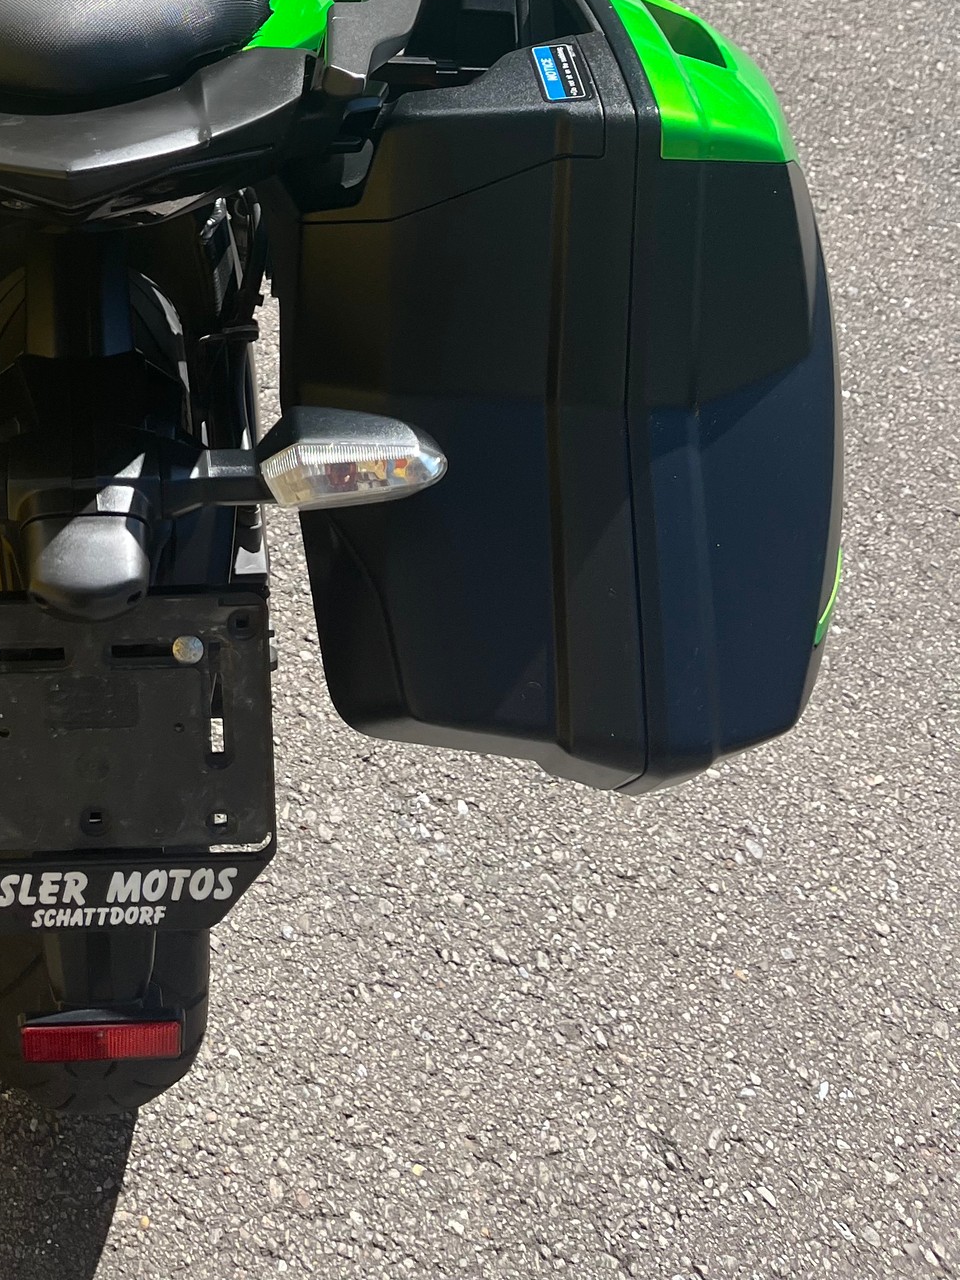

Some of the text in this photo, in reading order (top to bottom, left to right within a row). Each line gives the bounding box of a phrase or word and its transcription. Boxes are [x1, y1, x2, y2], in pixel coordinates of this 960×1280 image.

[541, 58, 558, 81] NOTICE
[106, 867, 238, 903] MOTOS
[31, 906, 167, 928] SCHATTDORF
